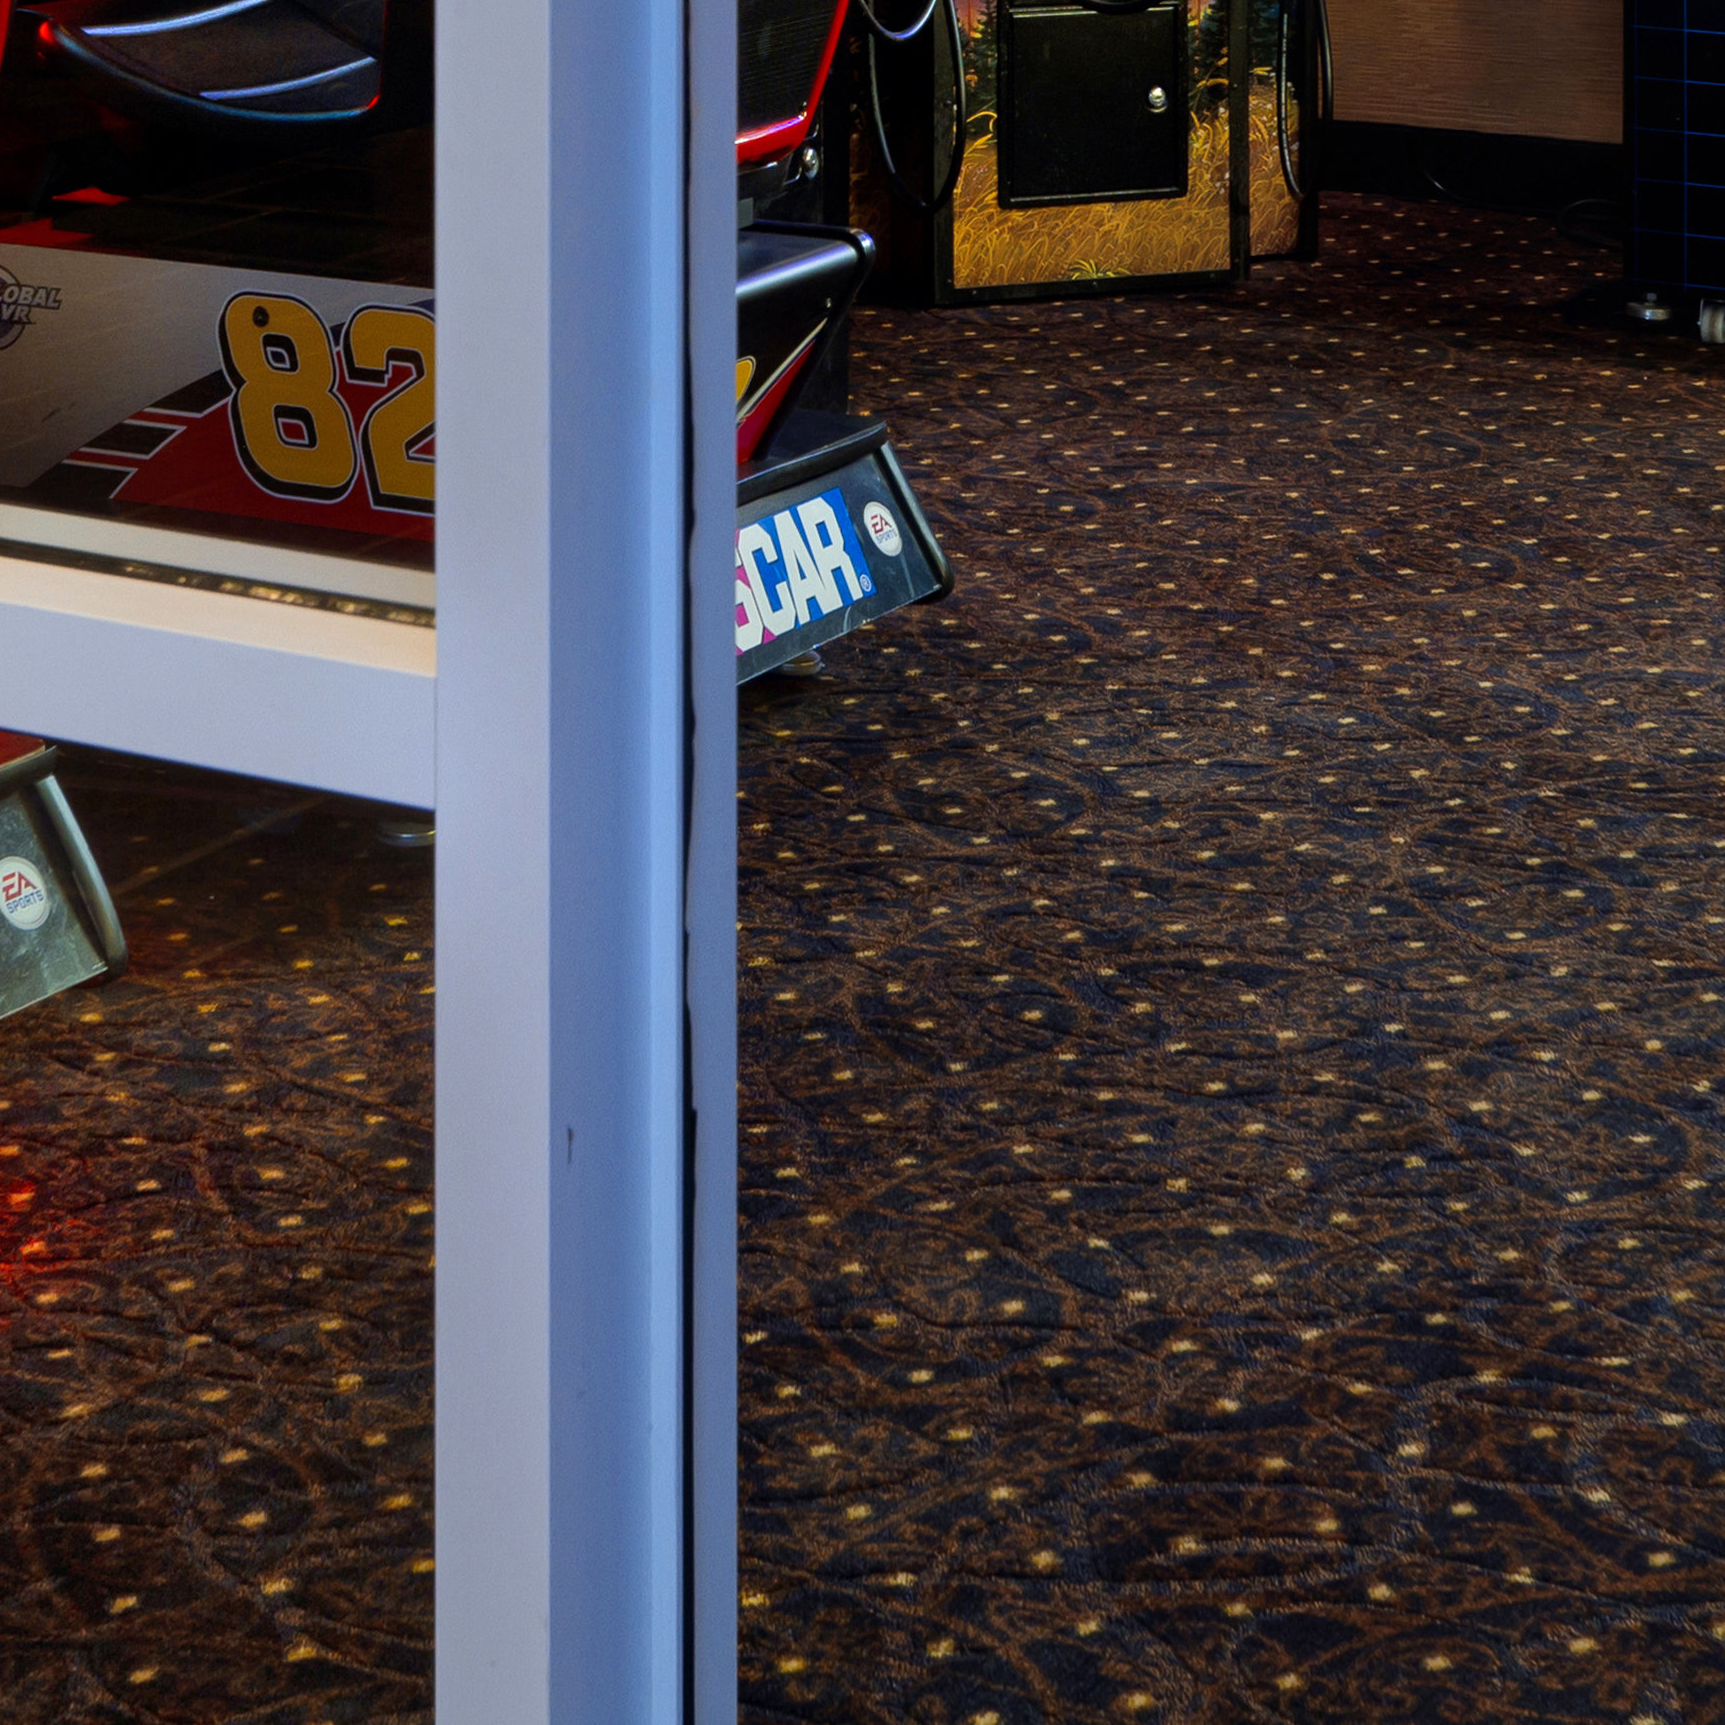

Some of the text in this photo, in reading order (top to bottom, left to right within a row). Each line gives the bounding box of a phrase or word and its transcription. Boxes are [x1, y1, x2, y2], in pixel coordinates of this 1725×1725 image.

[0, 302, 35, 325] VR
[216, 288, 435, 516] 82
[870, 512, 894, 535] EA
[2, 872, 39, 899] EA
[5, 889, 45, 914] SPORTS
